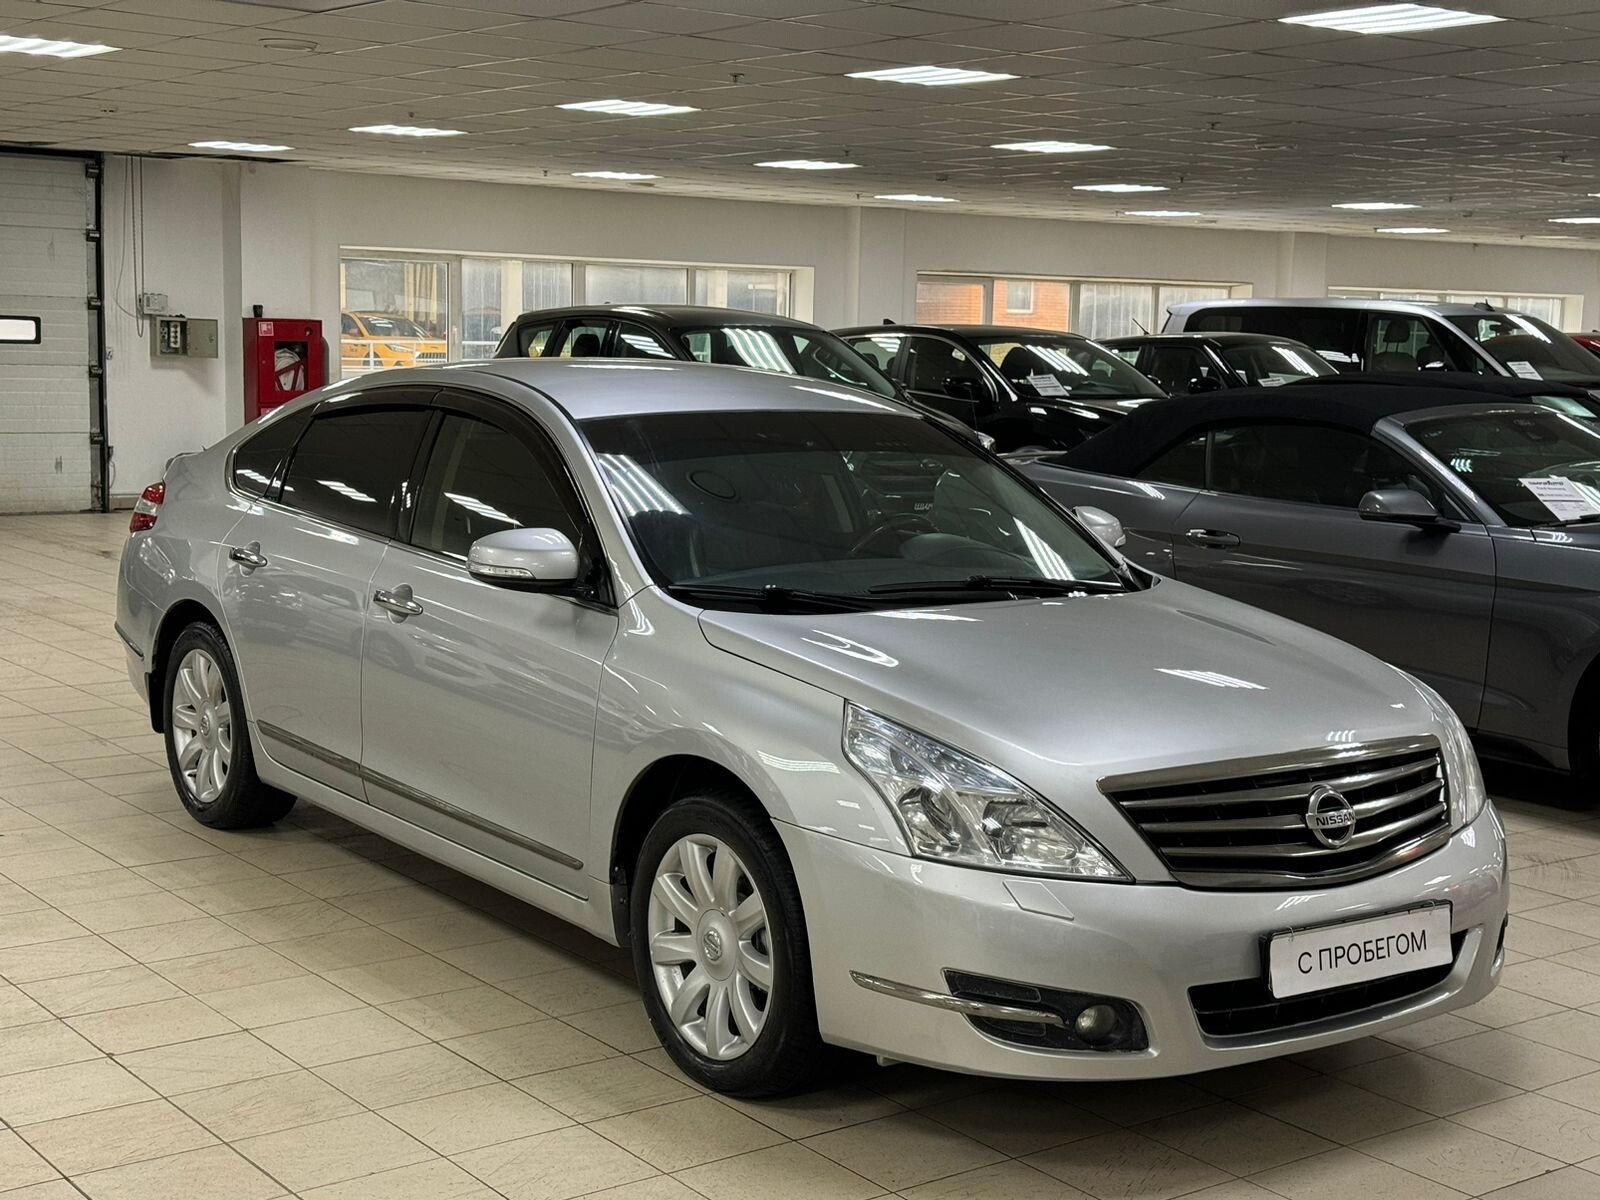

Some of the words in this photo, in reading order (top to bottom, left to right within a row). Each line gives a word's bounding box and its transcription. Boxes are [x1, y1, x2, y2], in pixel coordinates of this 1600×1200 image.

[1315, 813, 1354, 826] NISSAN
[1297, 951, 1313, 974] С
[1318, 929, 1427, 971] ПРОБЕГОМ
